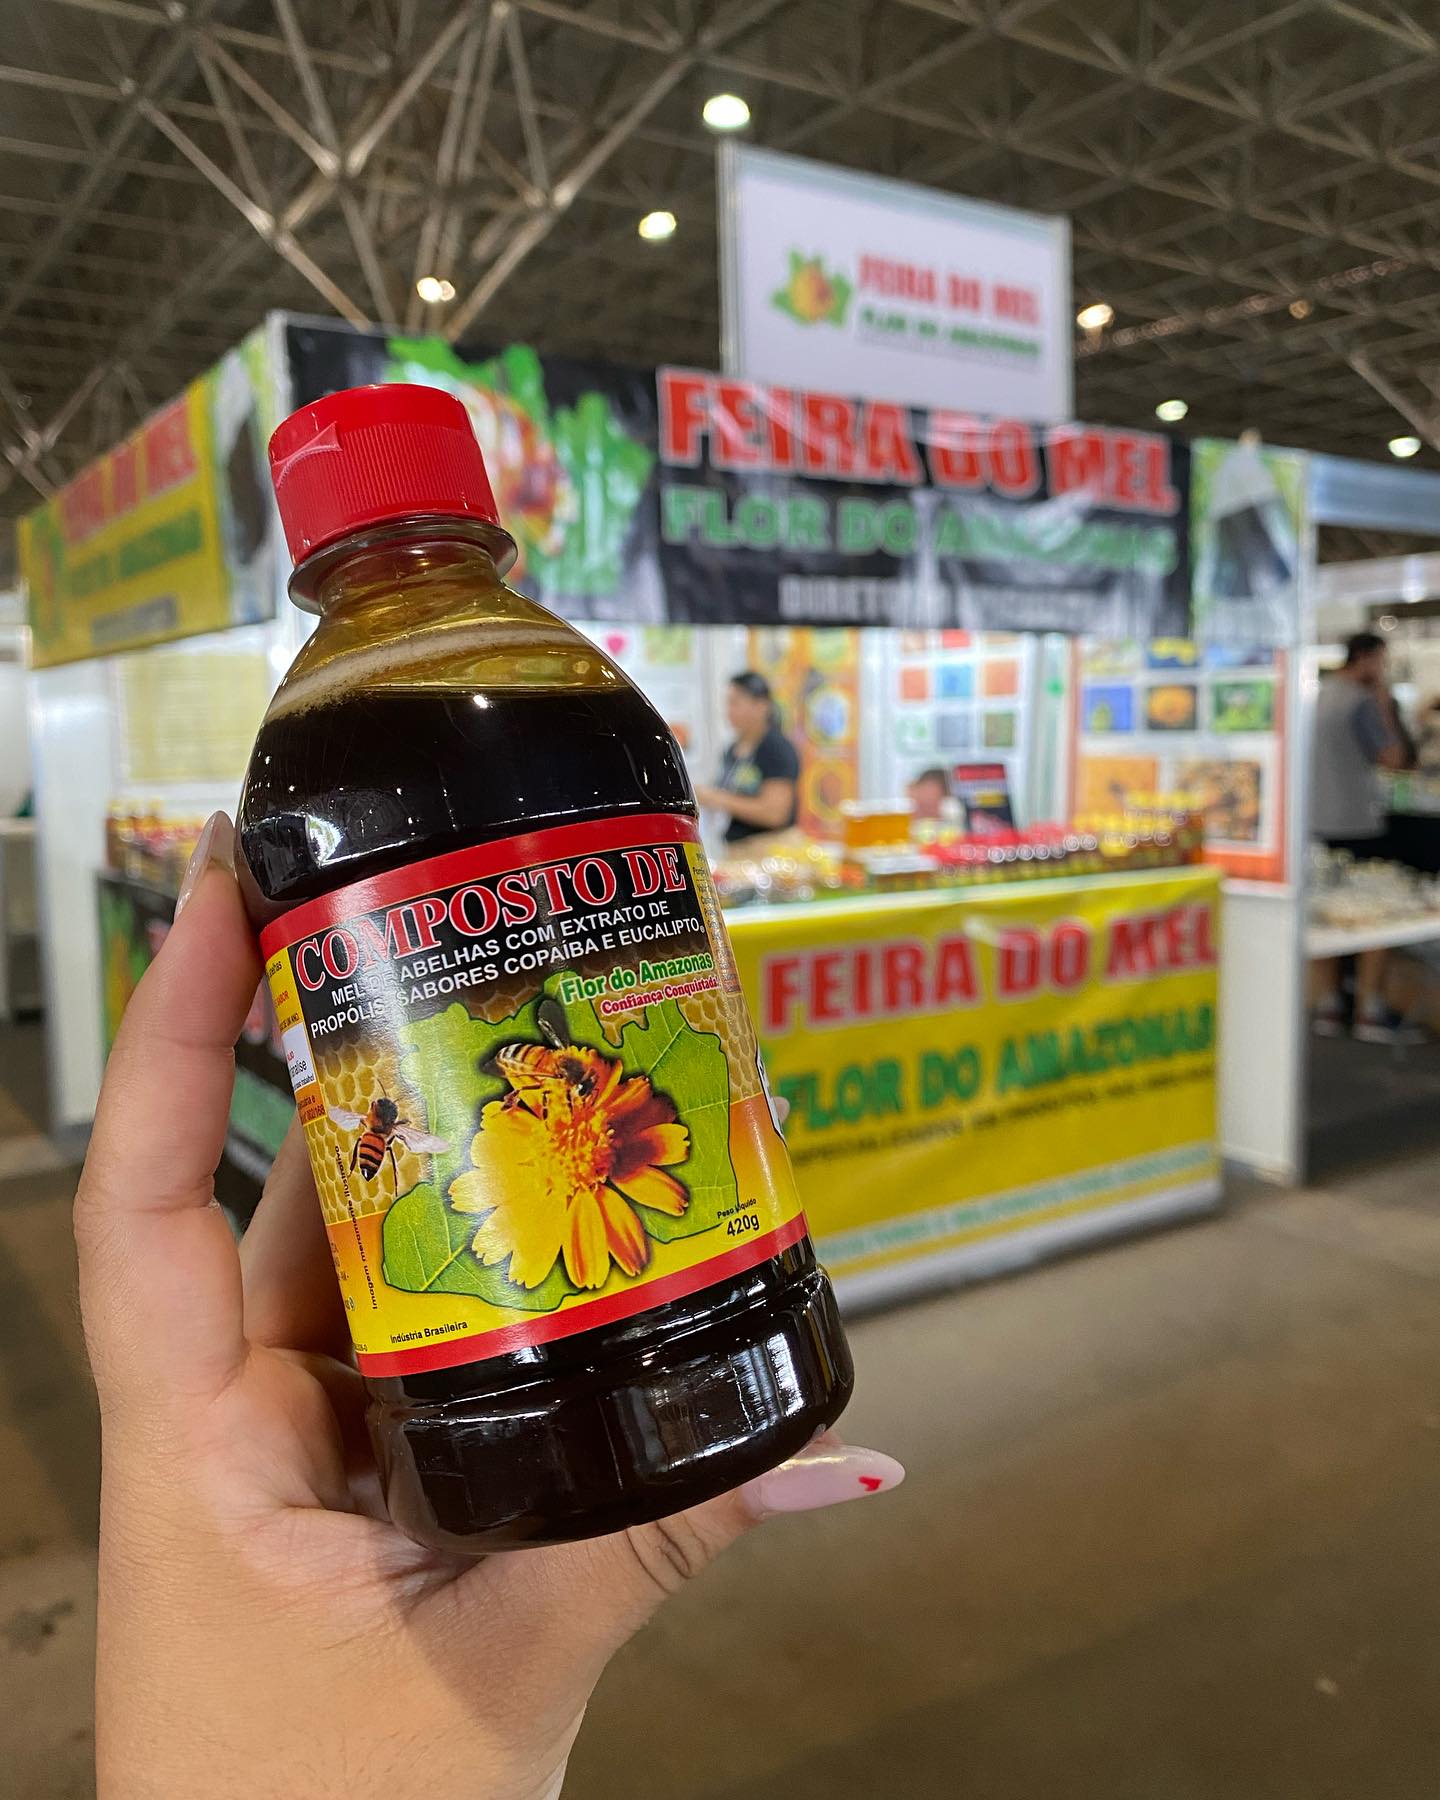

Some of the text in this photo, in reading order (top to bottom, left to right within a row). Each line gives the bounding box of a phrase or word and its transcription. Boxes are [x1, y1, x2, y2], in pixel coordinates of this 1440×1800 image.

[660, 370, 1178, 511] FEIRA DO MEL
[661, 489, 829, 552] FLOR
[837, 495, 920, 556] DO
[296, 858, 616, 991] COMPOSTO
[622, 847, 687, 898] DE
[311, 999, 385, 1038] PROPÓLIS
[396, 963, 499, 1006] SABORES
[504, 939, 599, 975] COPAÍBA
[602, 933, 616, 950] E
[332, 901, 670, 1006] MEL DE ABELHAS COM EXTRATO DE
[561, 953, 713, 1004] Flor do Amazonas
[766, 937, 978, 1032] FEIRA
[999, 924, 1089, 995] DO
[1108, 907, 1216, 979] MEL
[602, 990, 664, 1015] Confiança
[780, 1056, 902, 1130] FLOR
[919, 1046, 980, 1107] DO
[348, 1199, 366, 1262] meramente
[717, 1208, 734, 1219] Peso
[727, 1214, 760, 1236] 420g
[364, 1265, 377, 1310] Imagem
[390, 1321, 468, 1344] Indústria Brasileira
